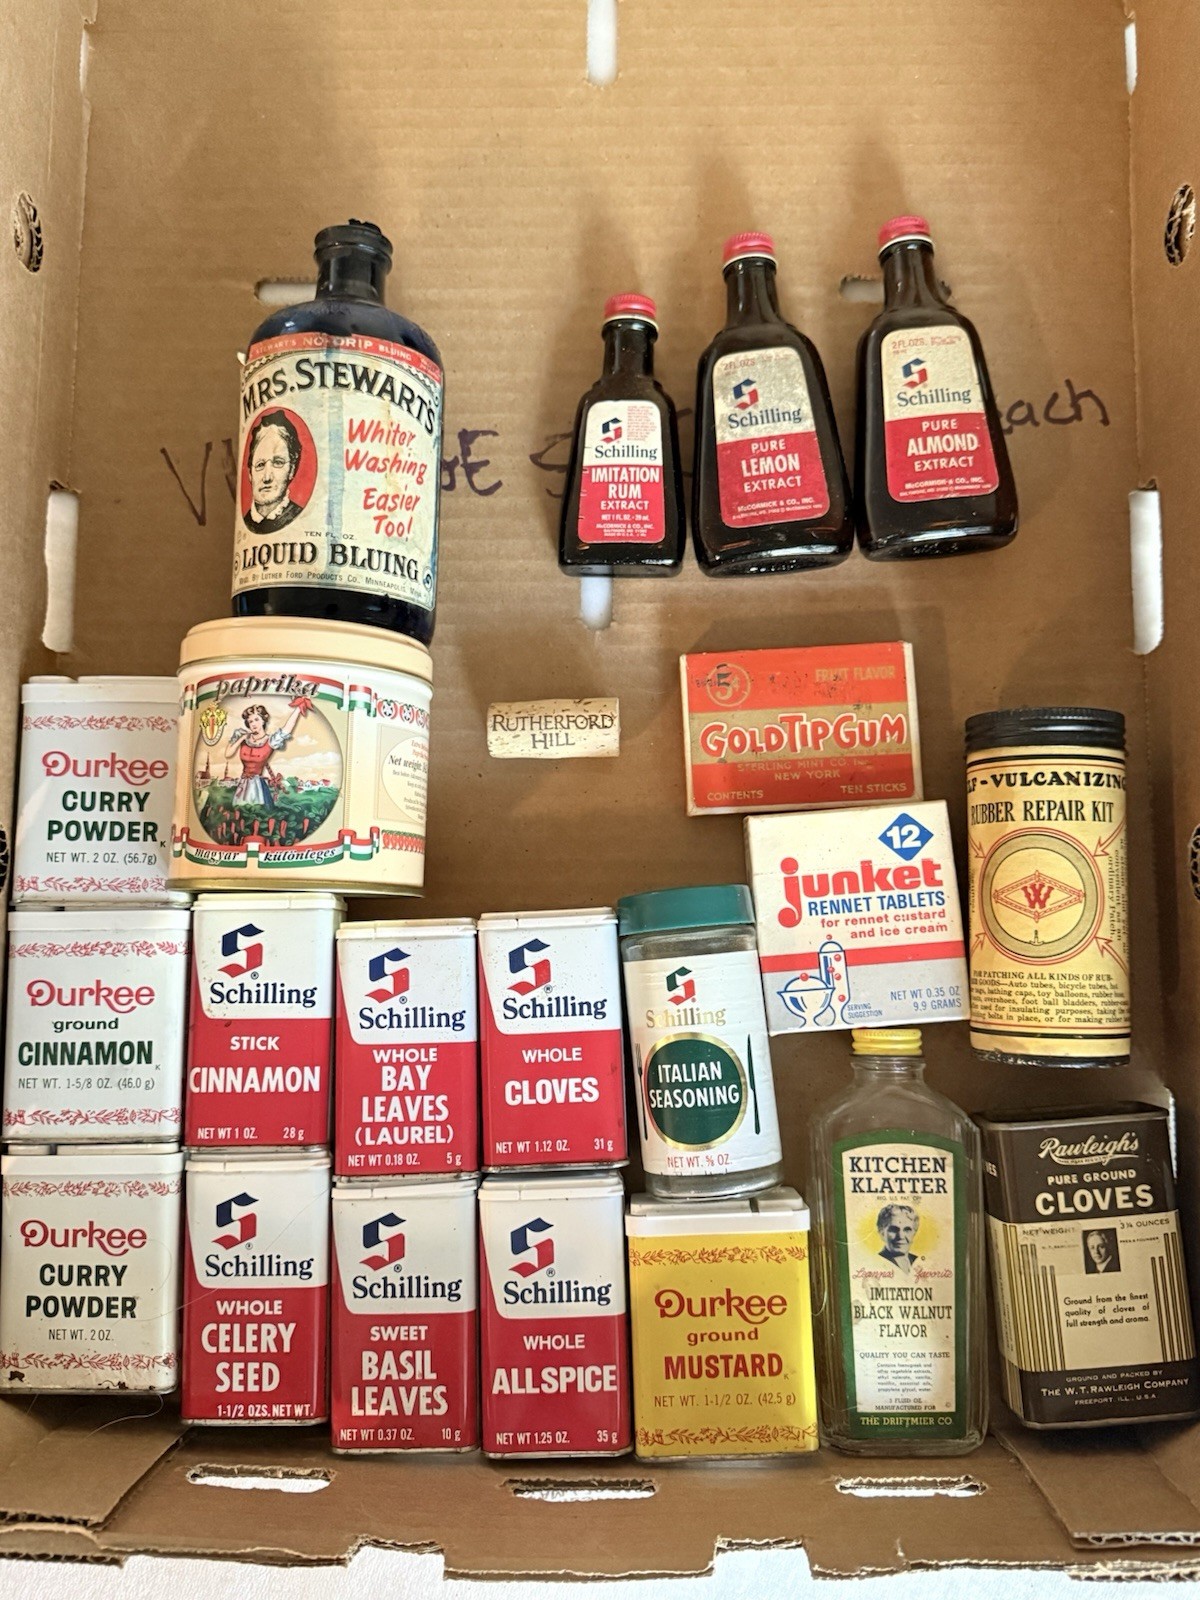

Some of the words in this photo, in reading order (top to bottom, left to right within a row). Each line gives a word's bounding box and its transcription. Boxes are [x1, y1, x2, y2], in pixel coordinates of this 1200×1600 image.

[378, 344, 412, 361] BLUING
[897, 389, 972, 407] Schilling
[727, 408, 803, 429] Schilling
[922, 419, 958, 432] PURE
[348, 417, 417, 445] Whiter
[595, 445, 657, 460] Schilling
[751, 439, 786, 453] PURE
[907, 433, 978, 457] ALMOND
[344, 448, 427, 485] Washing
[741, 453, 800, 477] LEMON
[914, 456, 974, 472] EXTRACT
[591, 467, 659, 482] IMITATION
[608, 484, 641, 498] RUM
[744, 476, 802, 493] EXTRACT
[363, 484, 421, 512] Easier
[601, 501, 648, 510] EXTRACT
[373, 514, 413, 541] Too!
[242, 541, 318, 571] LIQUID
[329, 543, 418, 582] BLUING
[216, 674, 321, 700] paprika
[492, 715, 614, 731] RUTHERFORD
[531, 733, 575, 749] HILL
[42, 751, 168, 785] Durkee
[774, 772, 800, 781] NEW
[806, 769, 840, 779] YORK
[707, 790, 764, 801] CONTENTS
[840, 785, 863, 794] TEN
[867, 783, 907, 793] STICKS
[62, 790, 150, 812] CURRY
[971, 801, 1015, 825] RUBBER
[1023, 800, 1085, 821] REPAIR
[1092, 801, 1114, 823] KIT
[47, 820, 158, 842] POWDER
[886, 824, 922, 849] 12
[47, 852, 66, 863] NET
[71, 853, 89, 863] WT.
[103, 853, 119, 863] OZ.
[778, 857, 944, 928] junket
[808, 897, 872, 917] RENNET
[877, 891, 945, 911] TABLETS
[821, 918, 838, 928] for
[845, 914, 889, 926] rennet
[894, 909, 946, 922] custard
[850, 928, 875, 939] and
[880, 926, 901, 936] ice
[905, 923, 948, 934] cream
[1049, 973, 1080, 981] KINDS
[1059, 982, 1086, 990] bicycle
[27, 979, 155, 1014] Durkee
[210, 982, 317, 1008] Schilling
[890, 991, 907, 1001] NET
[911, 989, 923, 999] WT
[927, 987, 946, 998] 0.35
[949, 986, 960, 996] OZ
[503, 996, 608, 1020] Schilling
[848, 1010, 883, 1019] SUGGESTION
[913, 1002, 928, 1011] 9.9
[931, 999, 962, 1010] GRAMS
[1009, 1006, 1050, 1015] insulating
[1055, 1007, 1093, 1016] purposes,
[54, 1018, 119, 1033] ground
[359, 1006, 466, 1031] Schilling
[646, 1007, 727, 1028] Schilling
[230, 1036, 280, 1050] STICK
[18, 1041, 153, 1066] CINNAMON
[373, 1048, 438, 1063] WHOLE
[522, 1048, 582, 1063] WHOLE
[189, 1066, 321, 1093] CINNAMON
[381, 1065, 432, 1092] BAY
[658, 1061, 722, 1083] ITALIAN
[19, 1078, 38, 1089] NET
[43, 1078, 61, 1089] WT.
[67, 1078, 92, 1090] 1-5/8
[97, 1078, 112, 1089] OZ.
[505, 1077, 600, 1106] CLOVES
[649, 1085, 740, 1109] SEASONING
[362, 1095, 449, 1123] LEAVES
[354, 1125, 454, 1146] (LAUREL)
[496, 1142, 513, 1153] NET
[517, 1141, 531, 1153] WT
[535, 1141, 552, 1152] 1.12
[1038, 1132, 1139, 1166] Rawleigh's
[849, 1157, 946, 1173] KITCHEN
[851, 1178, 947, 1193] KLATTER
[1047, 1173, 1078, 1185] PURE
[1083, 1169, 1136, 1182] GROUND
[1035, 1184, 1154, 1216] CLOVES
[1136, 1218, 1170, 1228] OUNCES
[20, 1219, 147, 1257] Durkee
[40, 1263, 128, 1287] CURRY
[205, 1254, 314, 1280] Schilling
[352, 1275, 463, 1302] Schilling
[504, 1280, 612, 1306] Schilling
[870, 1287, 933, 1301] IMITATION
[26, 1295, 137, 1318] POWDER
[216, 1300, 283, 1315] WHOLE
[655, 1288, 787, 1324] Durkee
[1064, 1296, 1092, 1306] Ground
[1130, 1292, 1148, 1301] finest
[854, 1306, 894, 1319] BLACK
[899, 1306, 952, 1319] WALNUT
[201, 1323, 297, 1353] CELERY
[370, 1325, 428, 1341] SWEET
[687, 1328, 758, 1346] ground
[880, 1324, 927, 1338] FLAVOR
[523, 1334, 586, 1350] WHOLE
[362, 1350, 437, 1381] BASIL
[665, 1353, 783, 1380] MUSTARD
[215, 1362, 280, 1392] SEED
[492, 1365, 617, 1395] ALLSPICE
[1041, 1388, 1060, 1396] THE
[1144, 1378, 1189, 1388] COMPANY
[217, 1405, 244, 1417] 1-1/2
[248, 1404, 271, 1417] OZS.
[272, 1404, 291, 1416] NET
[294, 1404, 313, 1416] WT.
[351, 1385, 448, 1417] LEAVES
[860, 1416, 879, 1425] THE
[883, 1416, 934, 1426] DRIFTMIER
